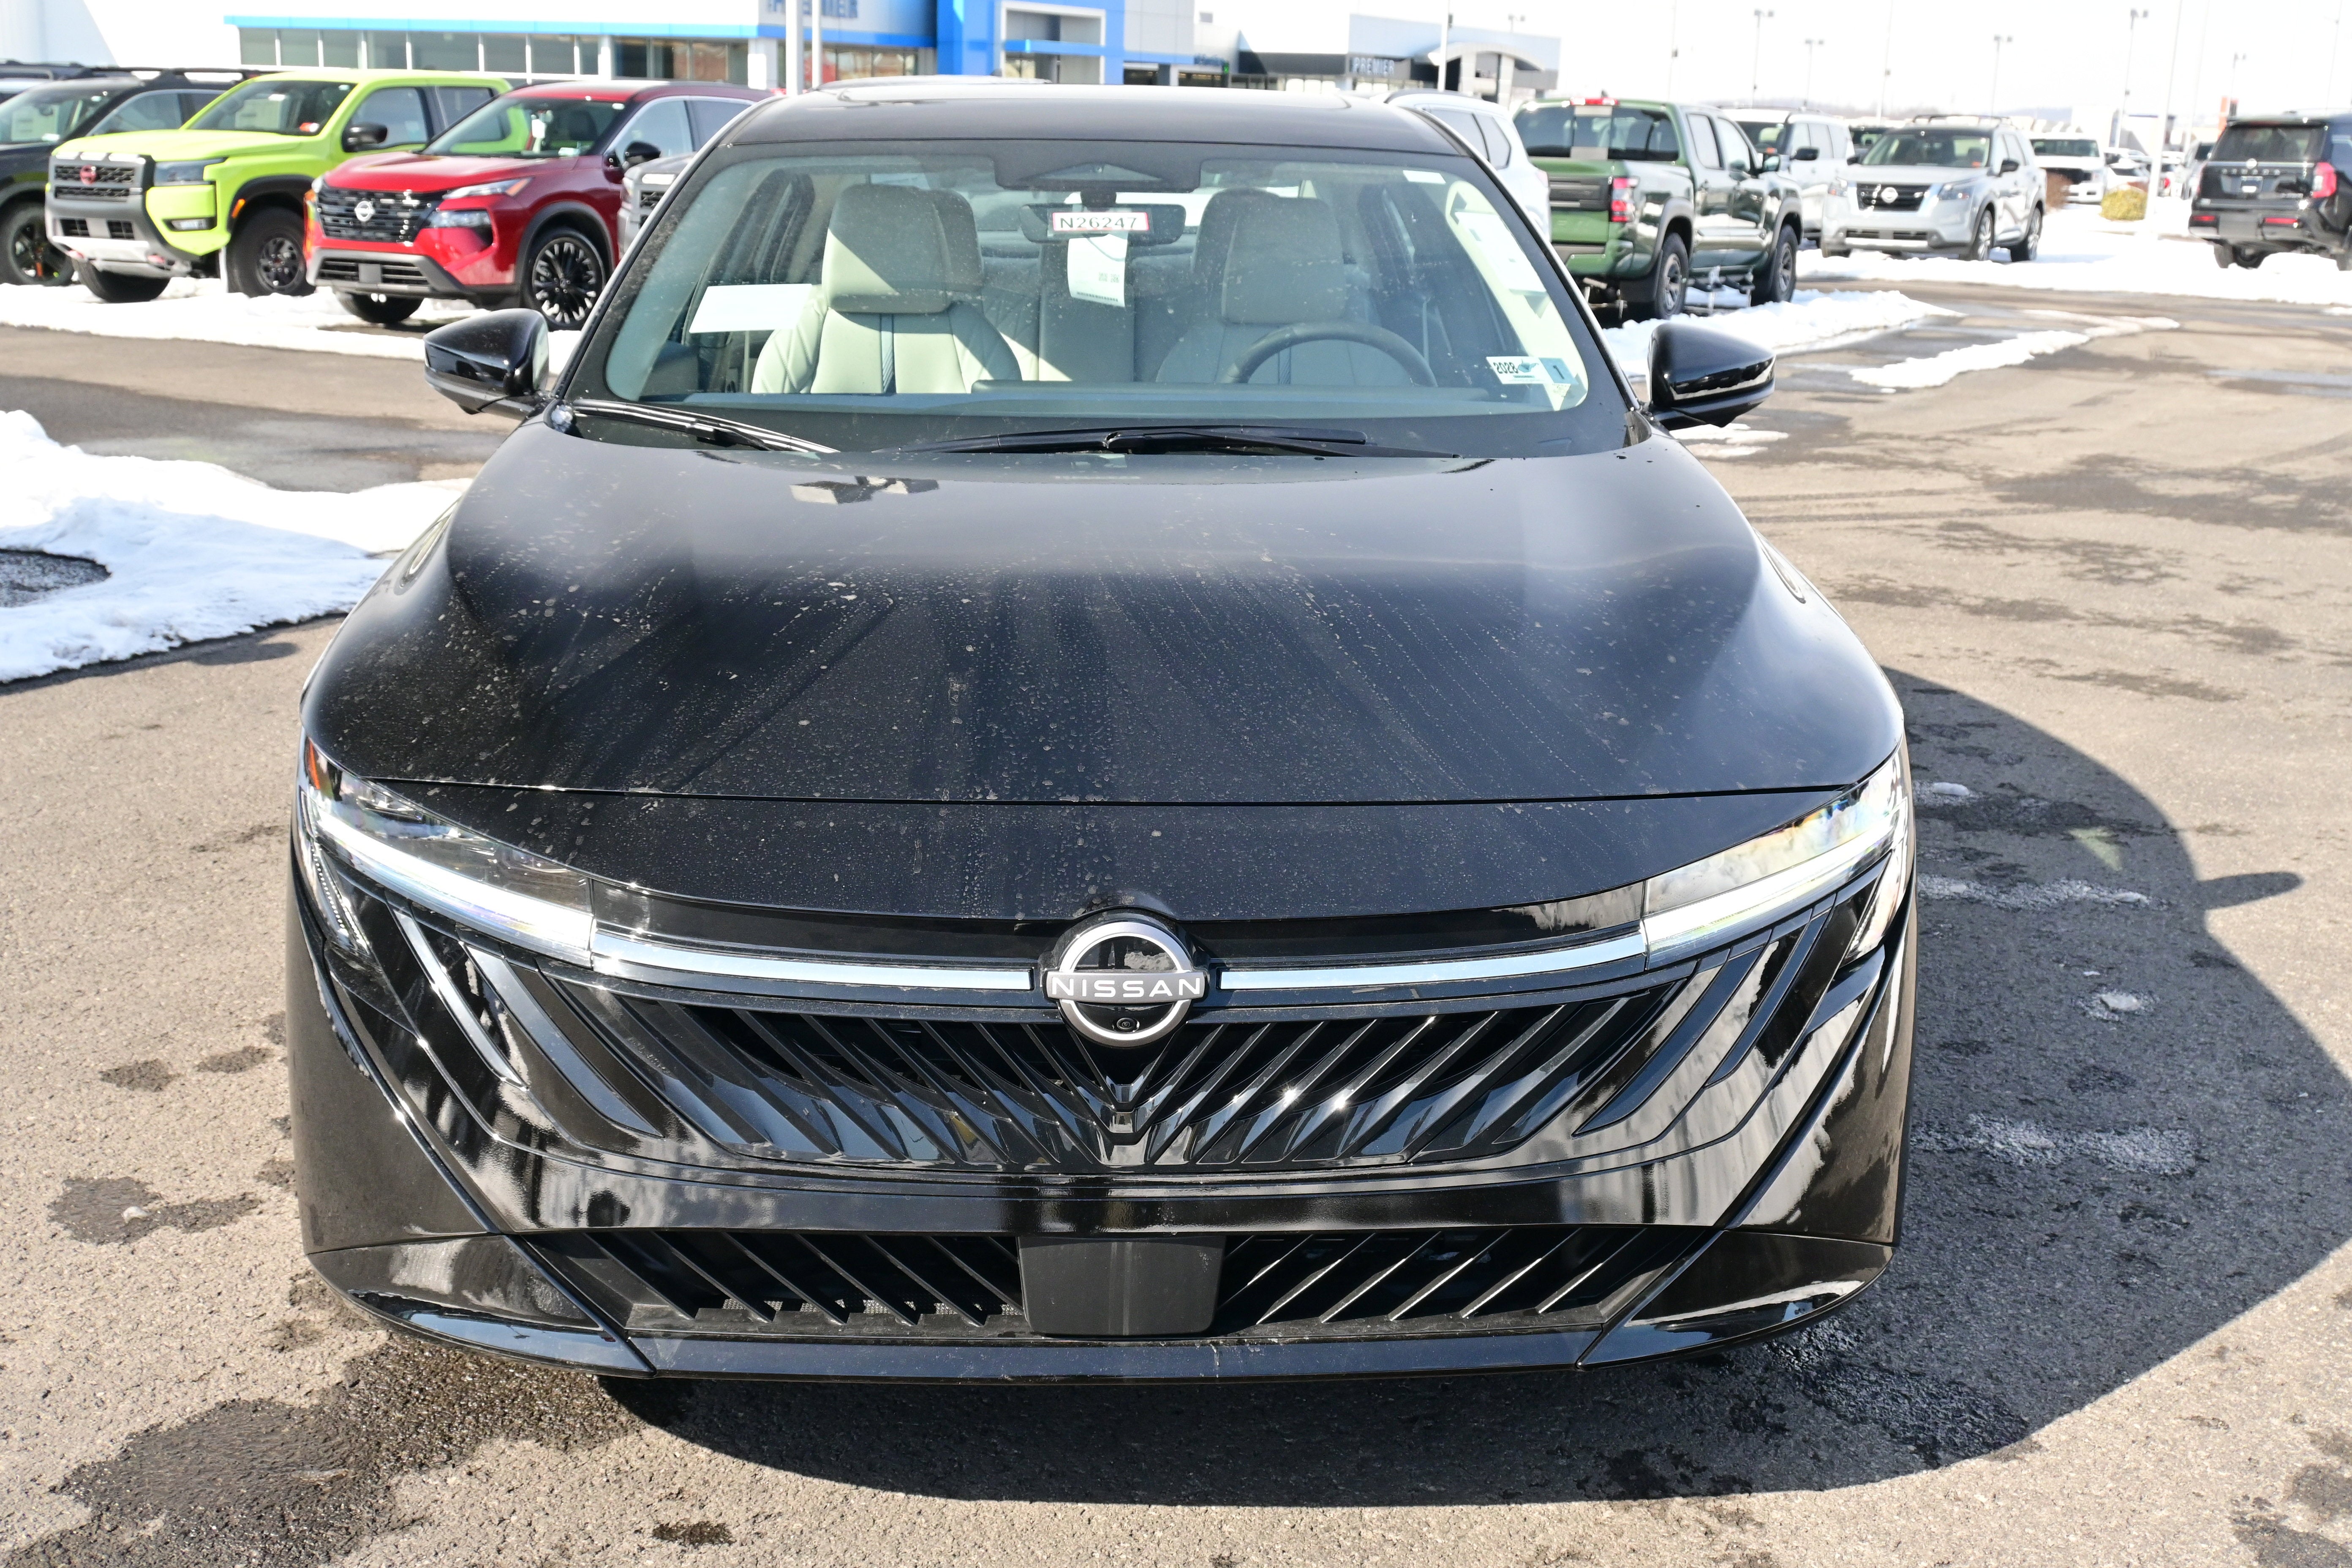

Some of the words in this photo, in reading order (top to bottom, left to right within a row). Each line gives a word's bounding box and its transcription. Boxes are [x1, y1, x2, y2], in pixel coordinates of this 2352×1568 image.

[1060, 217, 1137, 229] N26247
[1493, 362, 1519, 374] 2028
[1553, 365, 1565, 379] 1
[1052, 977, 1200, 997] NISSAN
